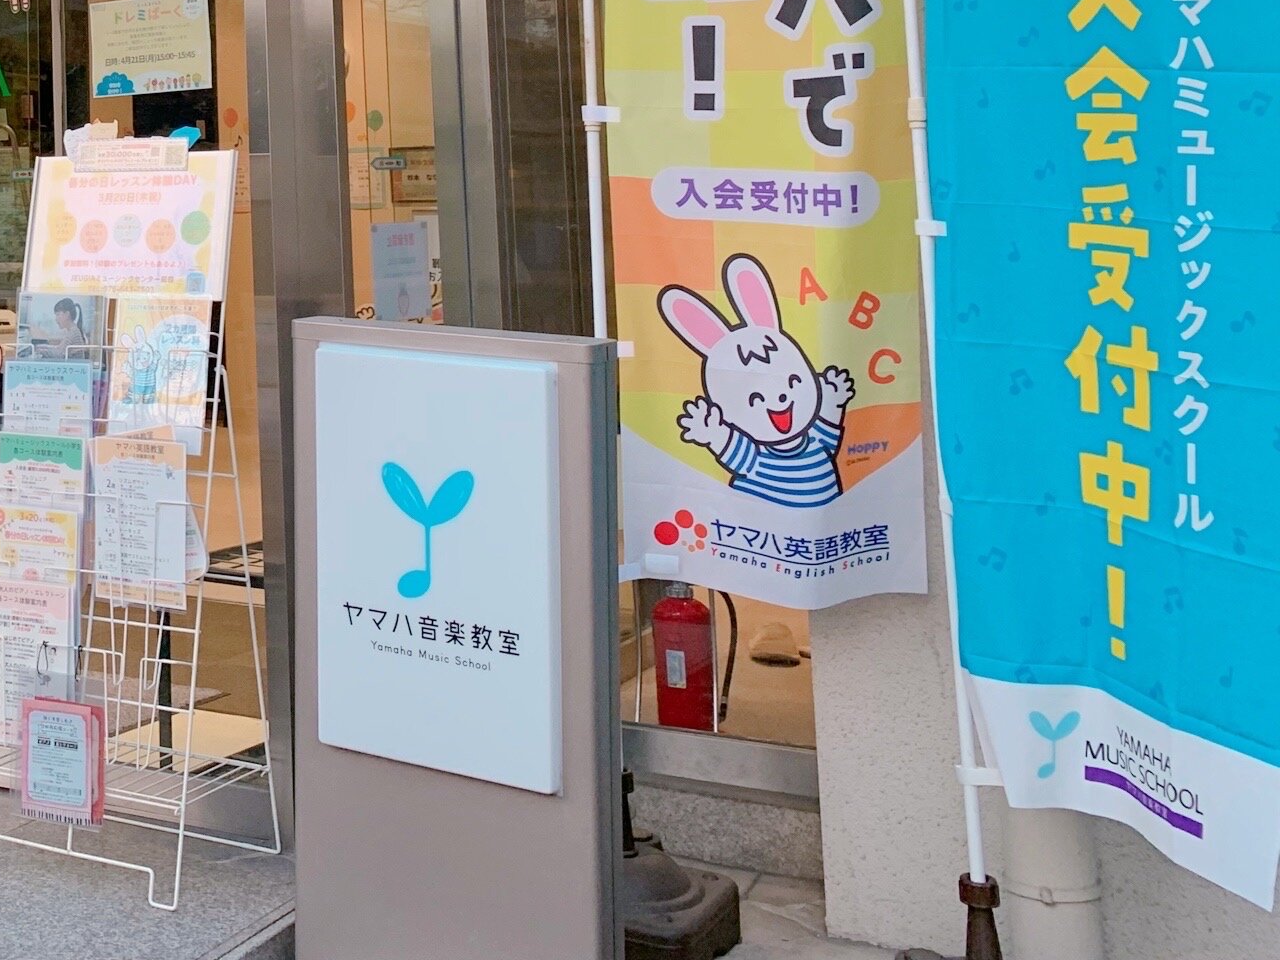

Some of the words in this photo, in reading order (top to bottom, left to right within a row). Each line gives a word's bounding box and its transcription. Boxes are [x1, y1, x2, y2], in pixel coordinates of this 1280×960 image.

[676, 177, 859, 216] 入会受付中!
[798, 267, 828, 305] A
[848, 291, 881, 330] B
[868, 349, 902, 385] C
[710, 519, 889, 561] ヤマハ英語教室
[711, 547, 766, 569] Yamaha
[776, 563, 835, 578] English
[843, 552, 890, 570] School
[343, 602, 521, 657] ヤマハ音楽教室
[370, 640, 413, 658] Yamaha
[419, 649, 450, 664] Music
[455, 655, 491, 672] School
[1116, 726, 1172, 776] YAMAHA
[1085, 740, 1136, 778] MUSIC
[1139, 764, 1204, 815] SCHOOL
